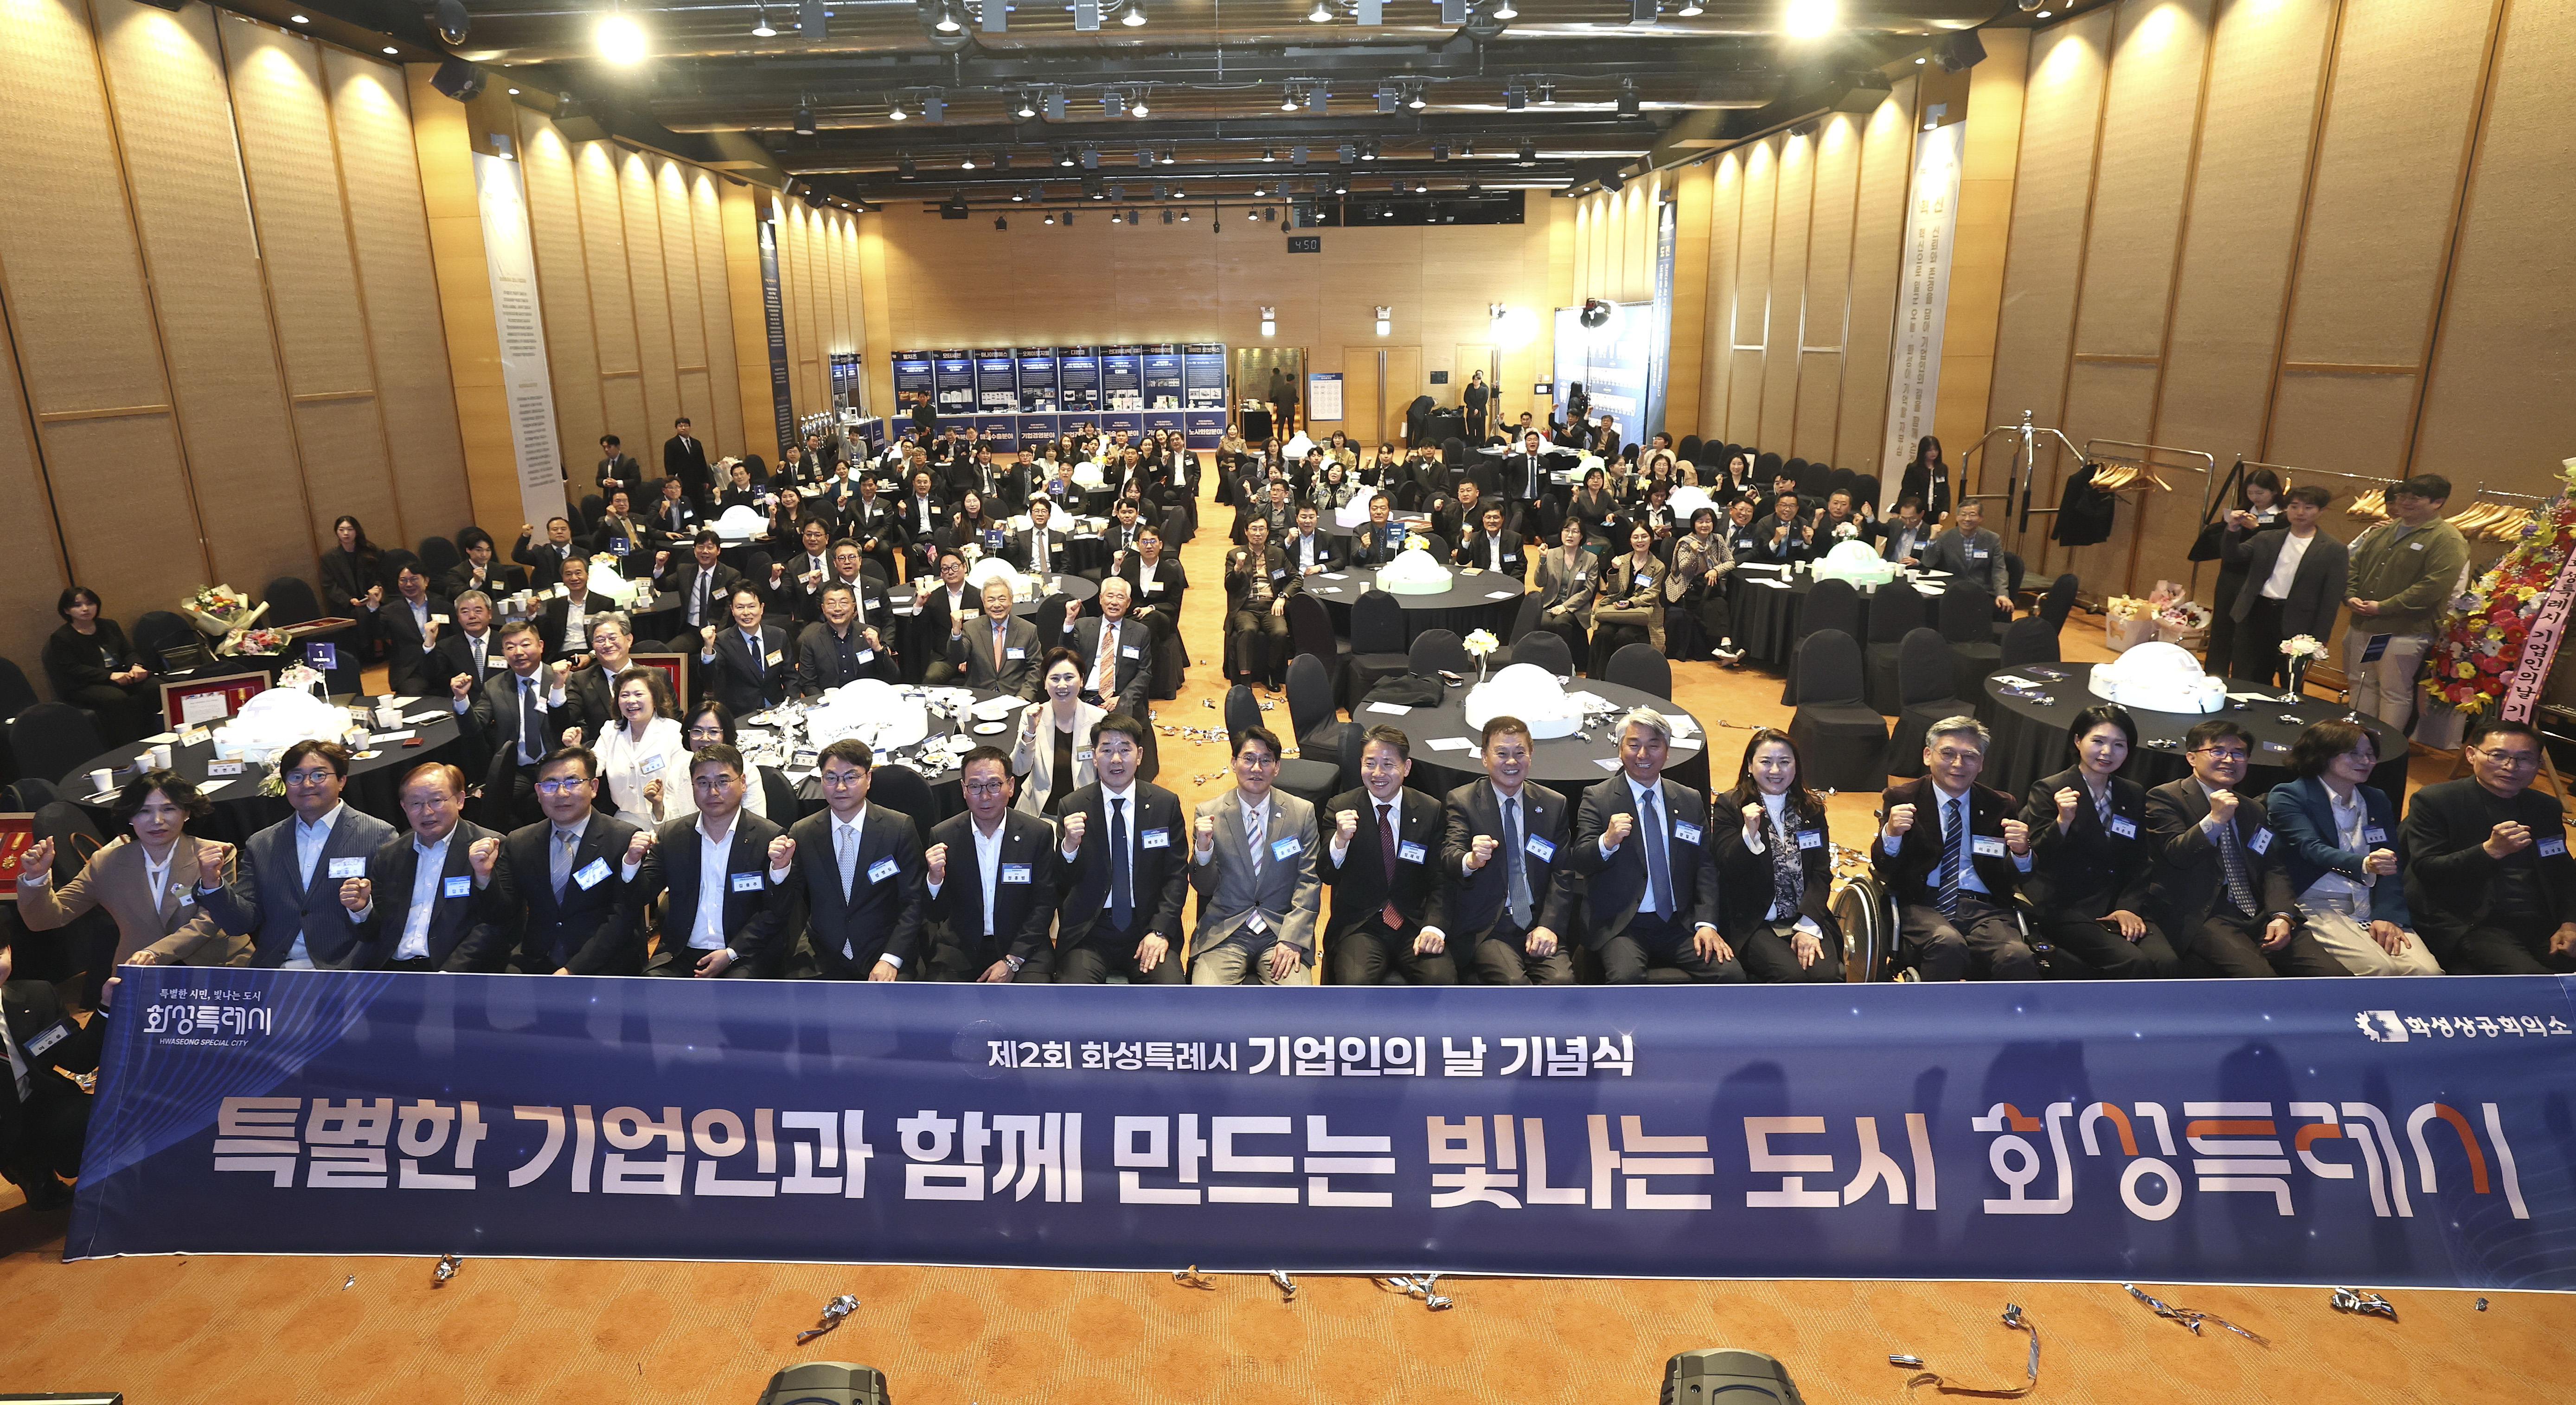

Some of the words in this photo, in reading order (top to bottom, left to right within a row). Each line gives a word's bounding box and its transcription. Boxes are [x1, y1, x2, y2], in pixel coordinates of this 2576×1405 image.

[160, 988, 188, 1000] 특별한
[189, 989, 211, 1001] 시민,
[214, 990, 241, 1002] 빛나는
[242, 990, 262, 1002] 도시
[143, 1004, 272, 1036] 화성특례시
[2404, 1015, 2573, 1039] 화성상공회의소
[159, 1038, 200, 1046] HWASEONG
[201, 1038, 229, 1047] SPECIAL
[987, 1040, 1072, 1070] 제2회
[1081, 1041, 1237, 1072] 화성특례시
[1248, 1036, 1426, 1077] 기업인의
[1442, 1036, 1487, 1077] 날
[1500, 1035, 1634, 1077] 기념식
[213, 1096, 487, 1190] 특별한
[508, 1105, 874, 1199] 기업인과
[897, 1110, 1083, 1203] 함께
[1113, 1113, 1396, 1207] 만드는
[1426, 1114, 1714, 1210] 빛나는
[1744, 1113, 1936, 1210] 도시
[1971, 1101, 2530, 1220] 화성특례시
